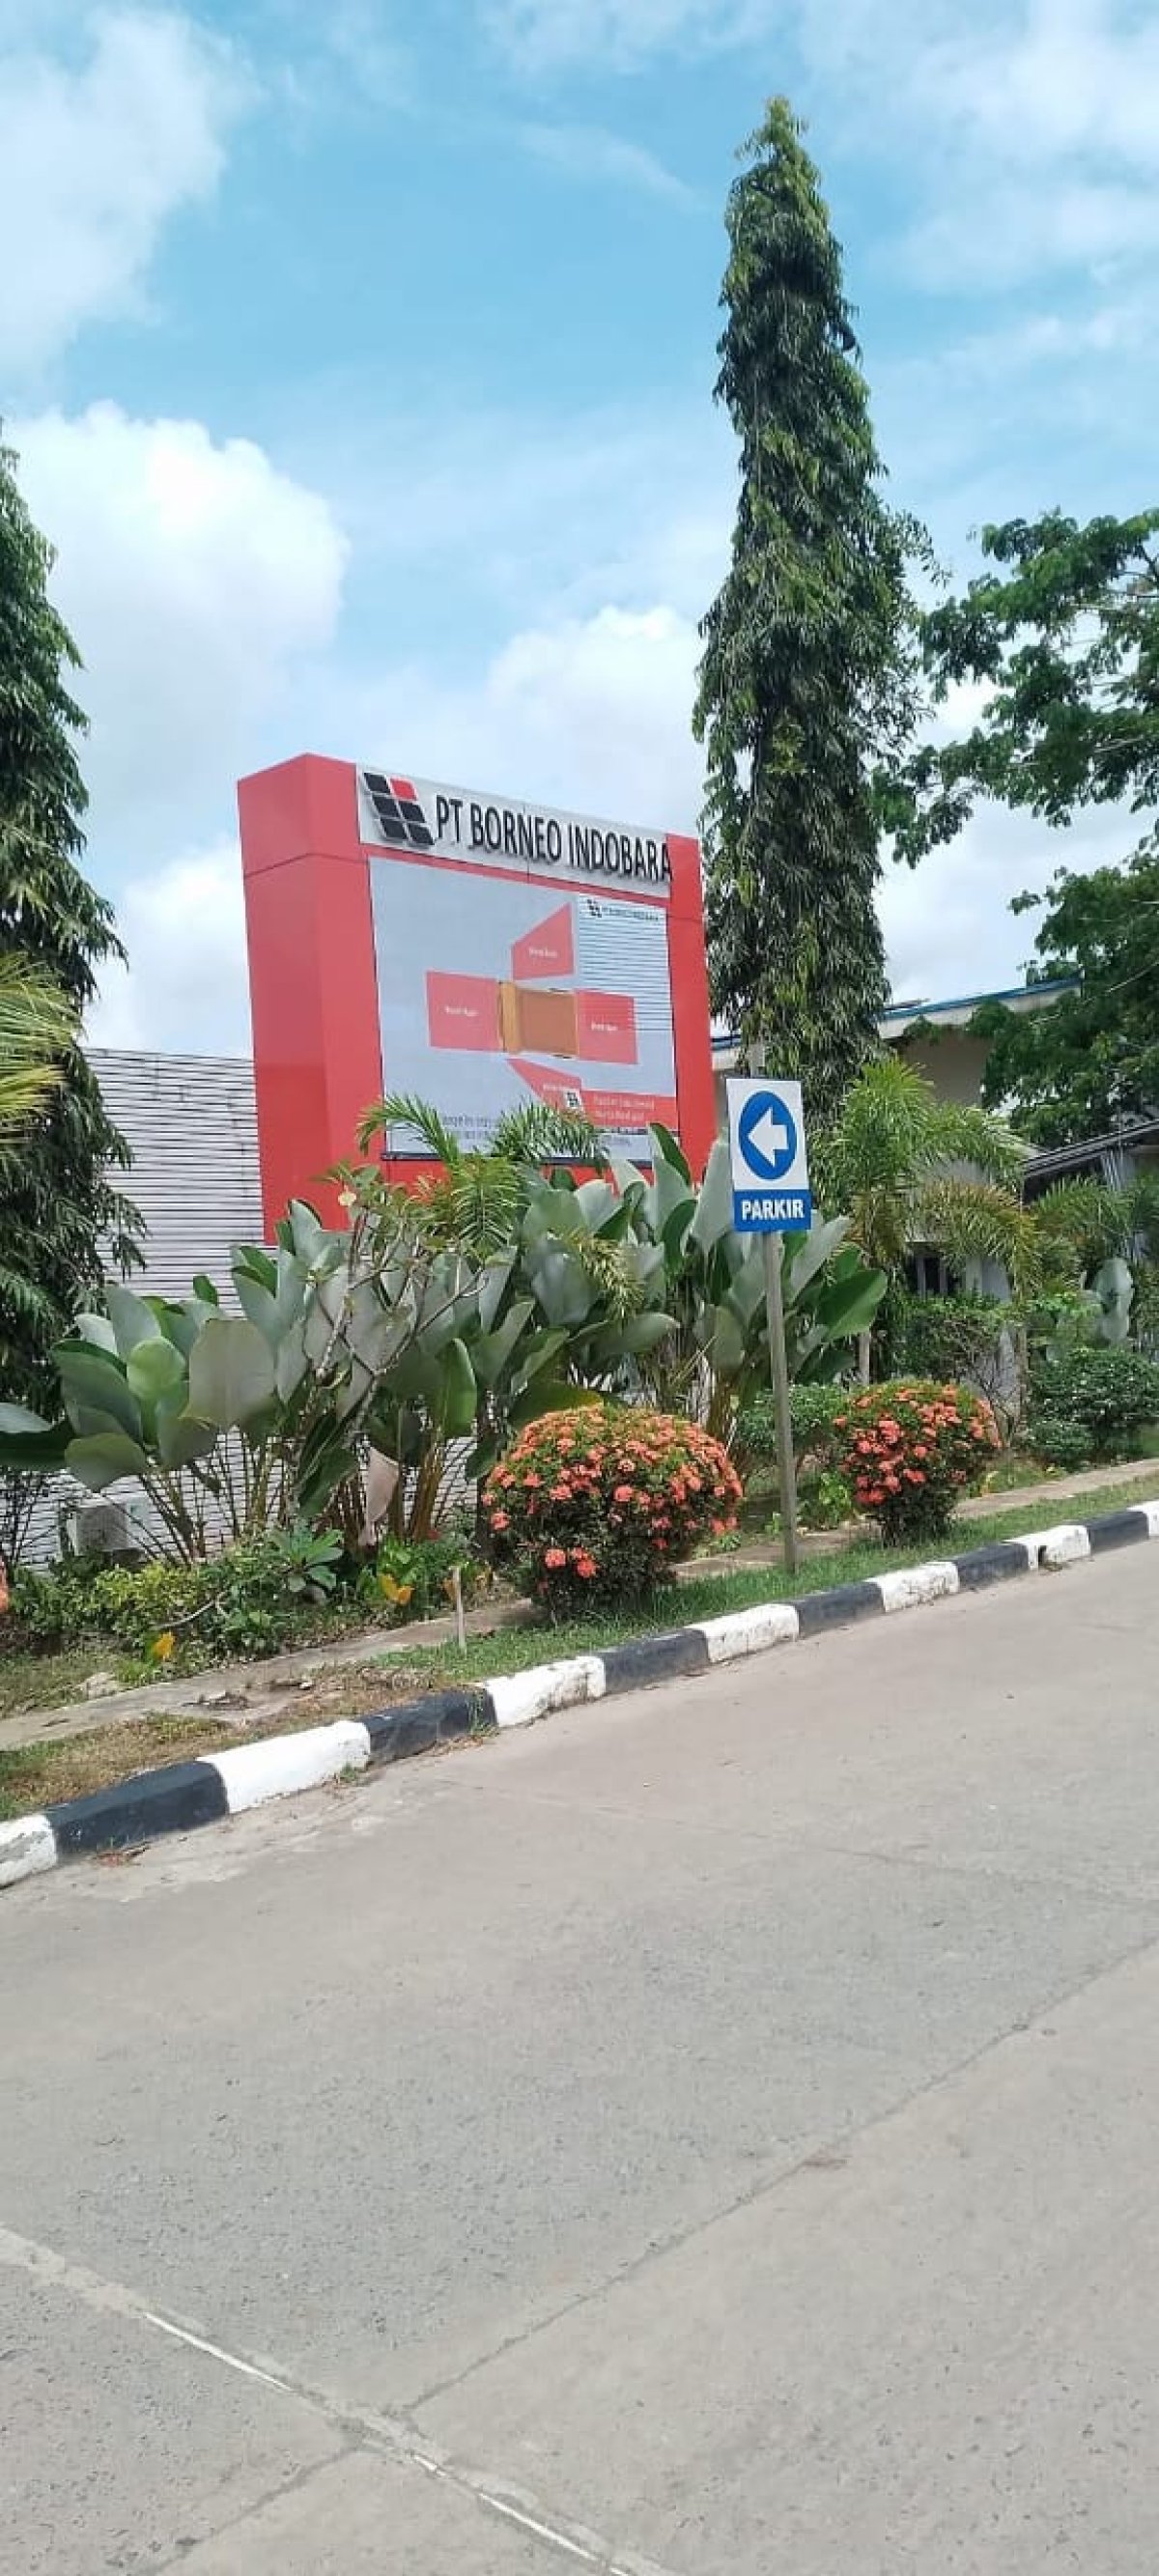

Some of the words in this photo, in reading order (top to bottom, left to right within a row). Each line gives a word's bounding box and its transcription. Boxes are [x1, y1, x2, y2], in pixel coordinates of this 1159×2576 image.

[436, 794, 463, 843] PT
[469, 802, 561, 861] BORNEO
[568, 824, 673, 883] INDOBARA
[741, 1199, 805, 1221] PARKIR
